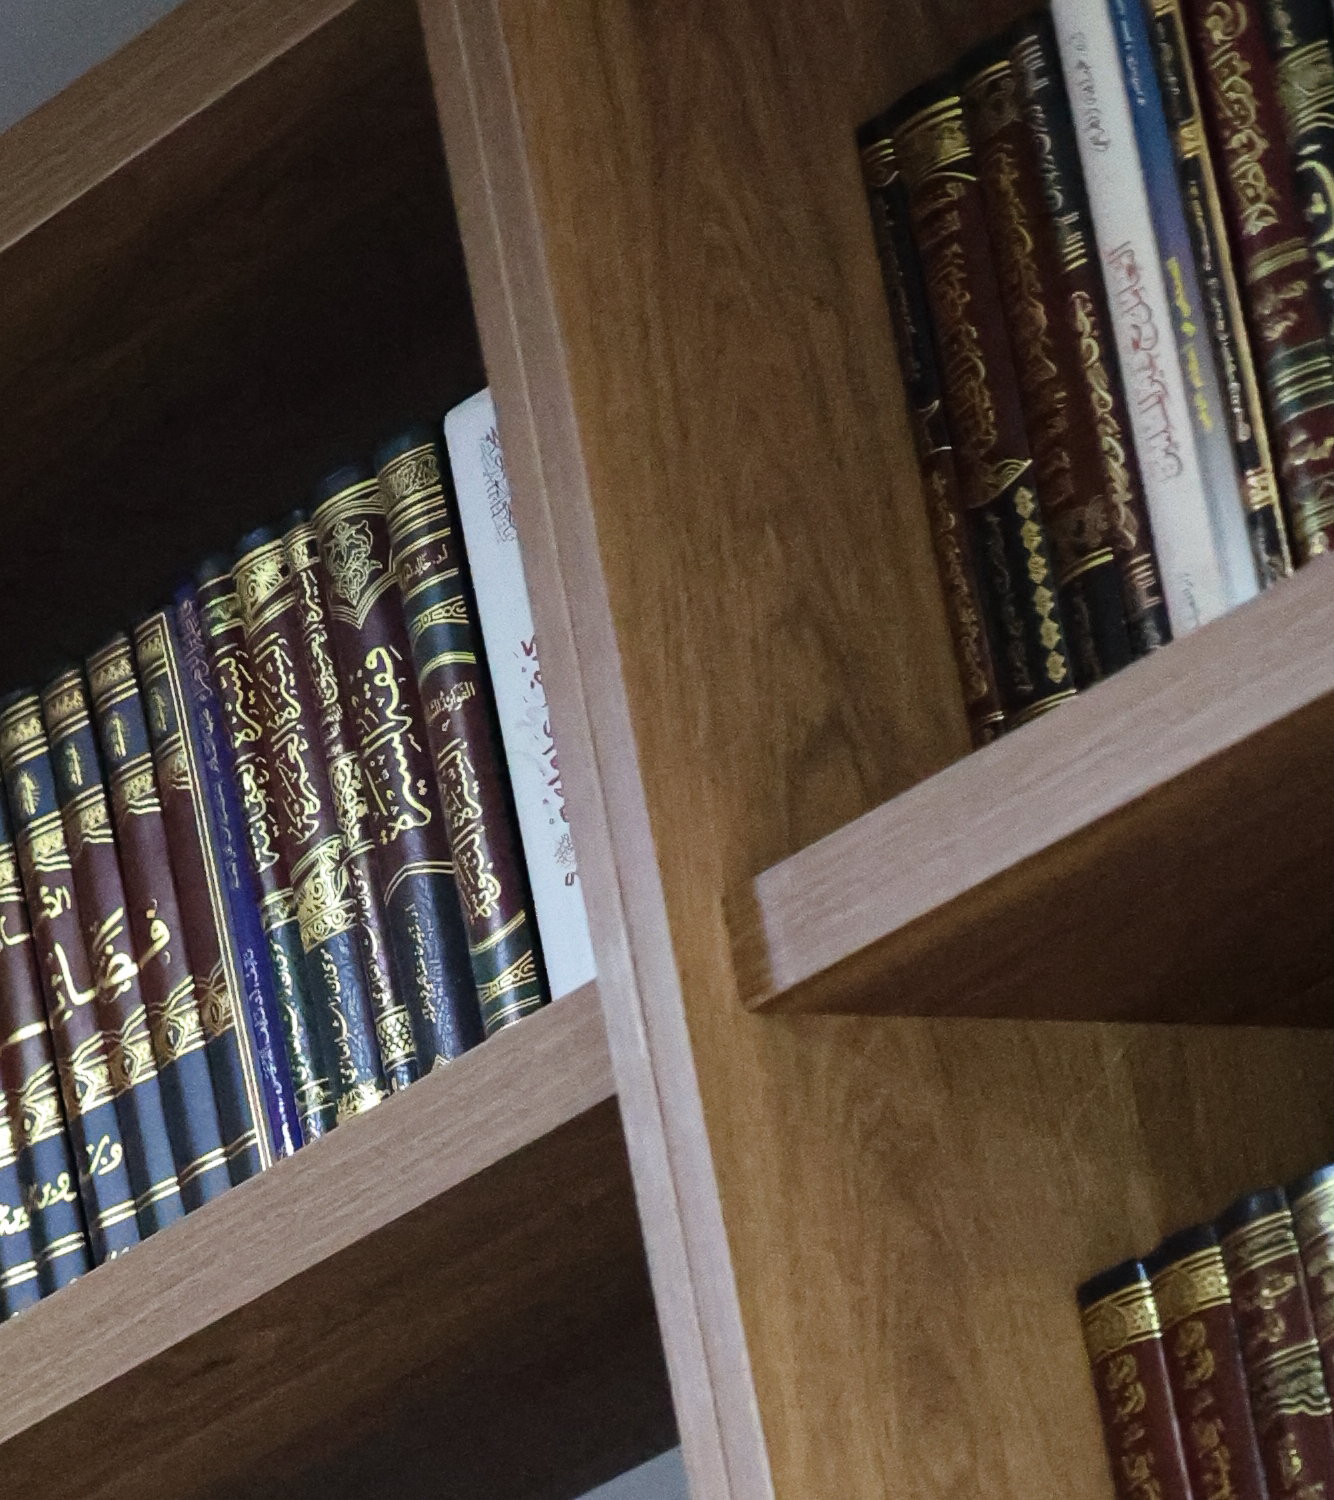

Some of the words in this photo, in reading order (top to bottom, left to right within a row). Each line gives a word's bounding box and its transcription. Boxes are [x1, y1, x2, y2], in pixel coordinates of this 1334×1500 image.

[214, 636, 261, 753] السيرة
[252, 626, 301, 734] السيرة
[345, 633, 407, 742] فقه
[269, 714, 323, 848] العمرية
[359, 708, 432, 851] السيرة
[433, 731, 481, 836] السيرة
[449, 813, 503, 930] النبوية
